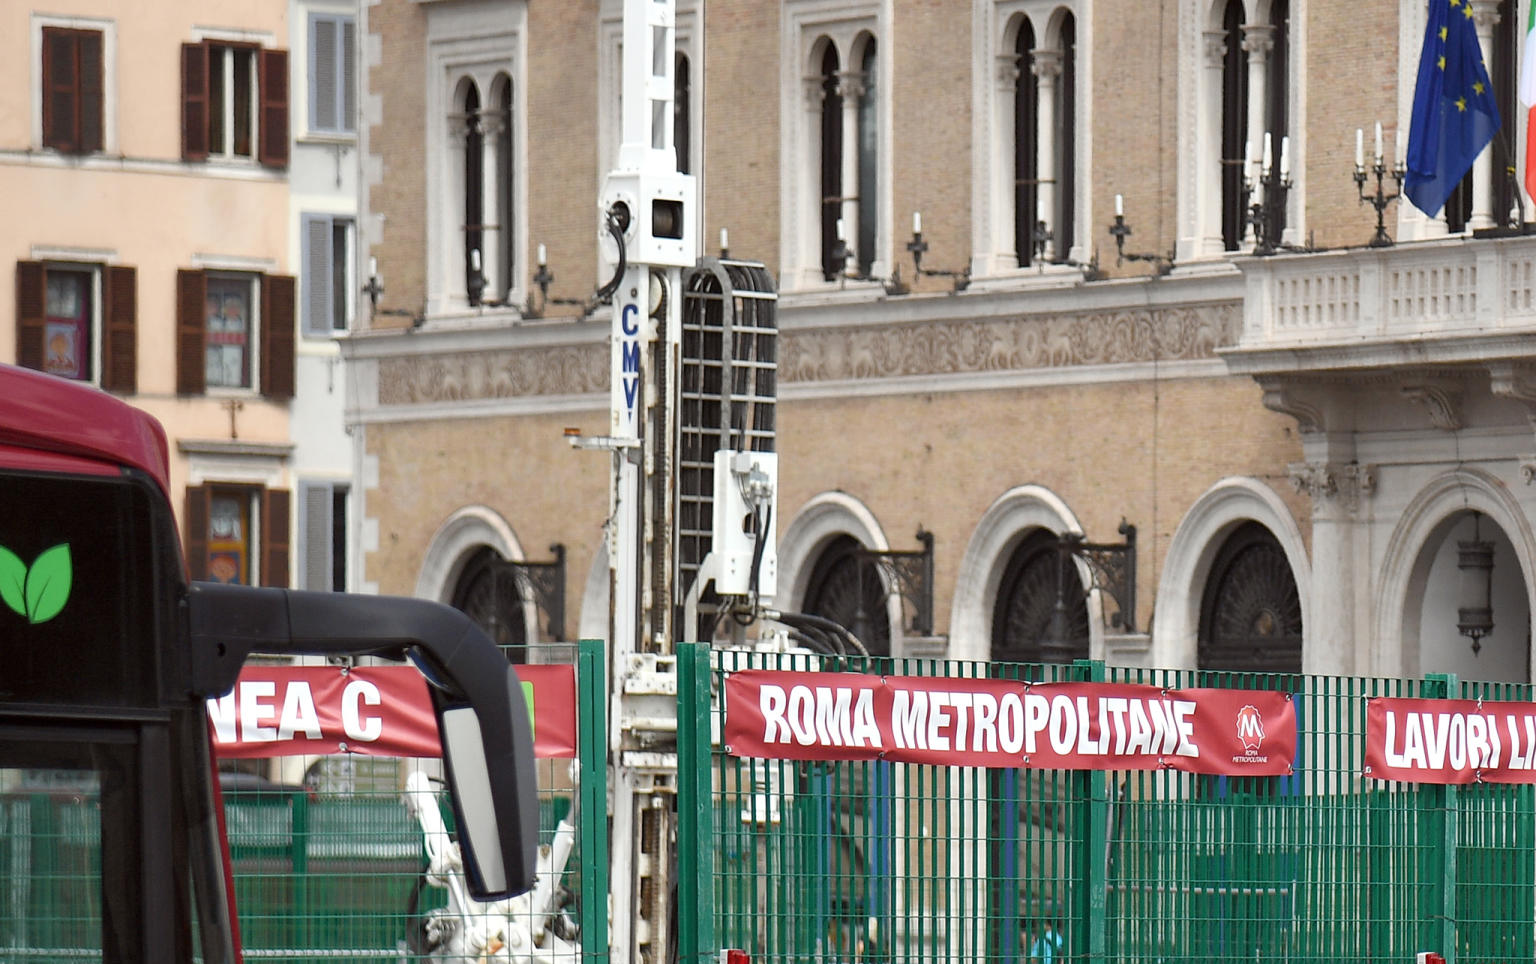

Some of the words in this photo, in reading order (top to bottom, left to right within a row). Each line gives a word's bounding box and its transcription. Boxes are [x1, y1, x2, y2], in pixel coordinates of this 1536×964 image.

[622, 303, 639, 409] CMV
[340, 680, 382, 742] C
[759, 684, 884, 749] ROMA
[891, 690, 1199, 758] METROPOLITANE
[1384, 710, 1500, 772] LAVORI
